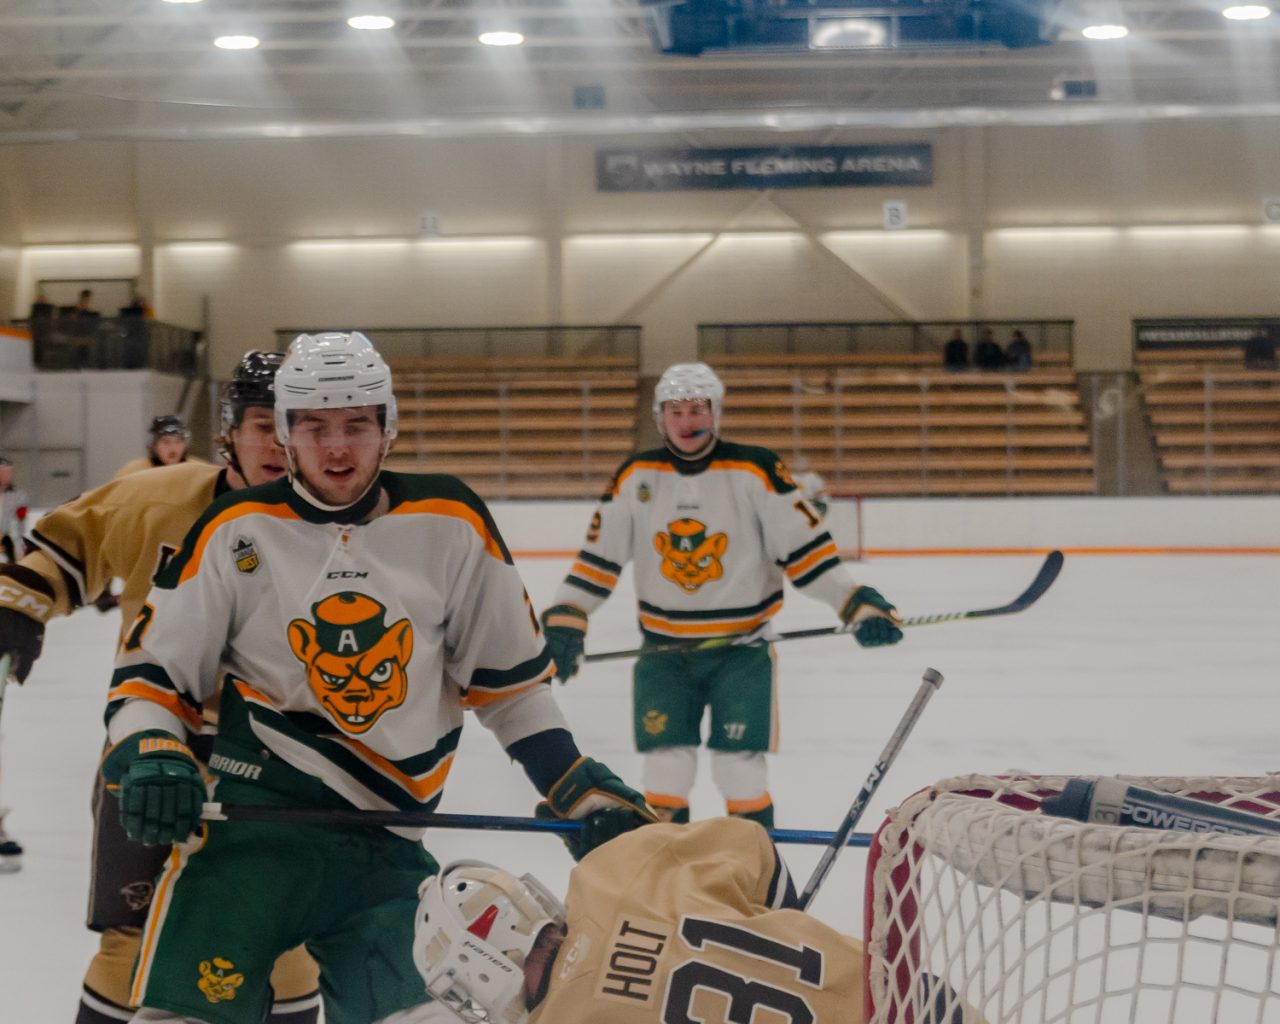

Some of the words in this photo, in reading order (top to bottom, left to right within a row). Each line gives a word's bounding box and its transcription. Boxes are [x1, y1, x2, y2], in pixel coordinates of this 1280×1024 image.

[643, 162, 727, 178] WAYNE
[732, 159, 836, 176] FLEMING
[840, 156, 922, 173] ARENA
[326, 570, 369, 580] CCM
[337, 629, 359, 653] A
[209, 753, 262, 780] RRIOR
[602, 920, 667, 1001] HOLT
